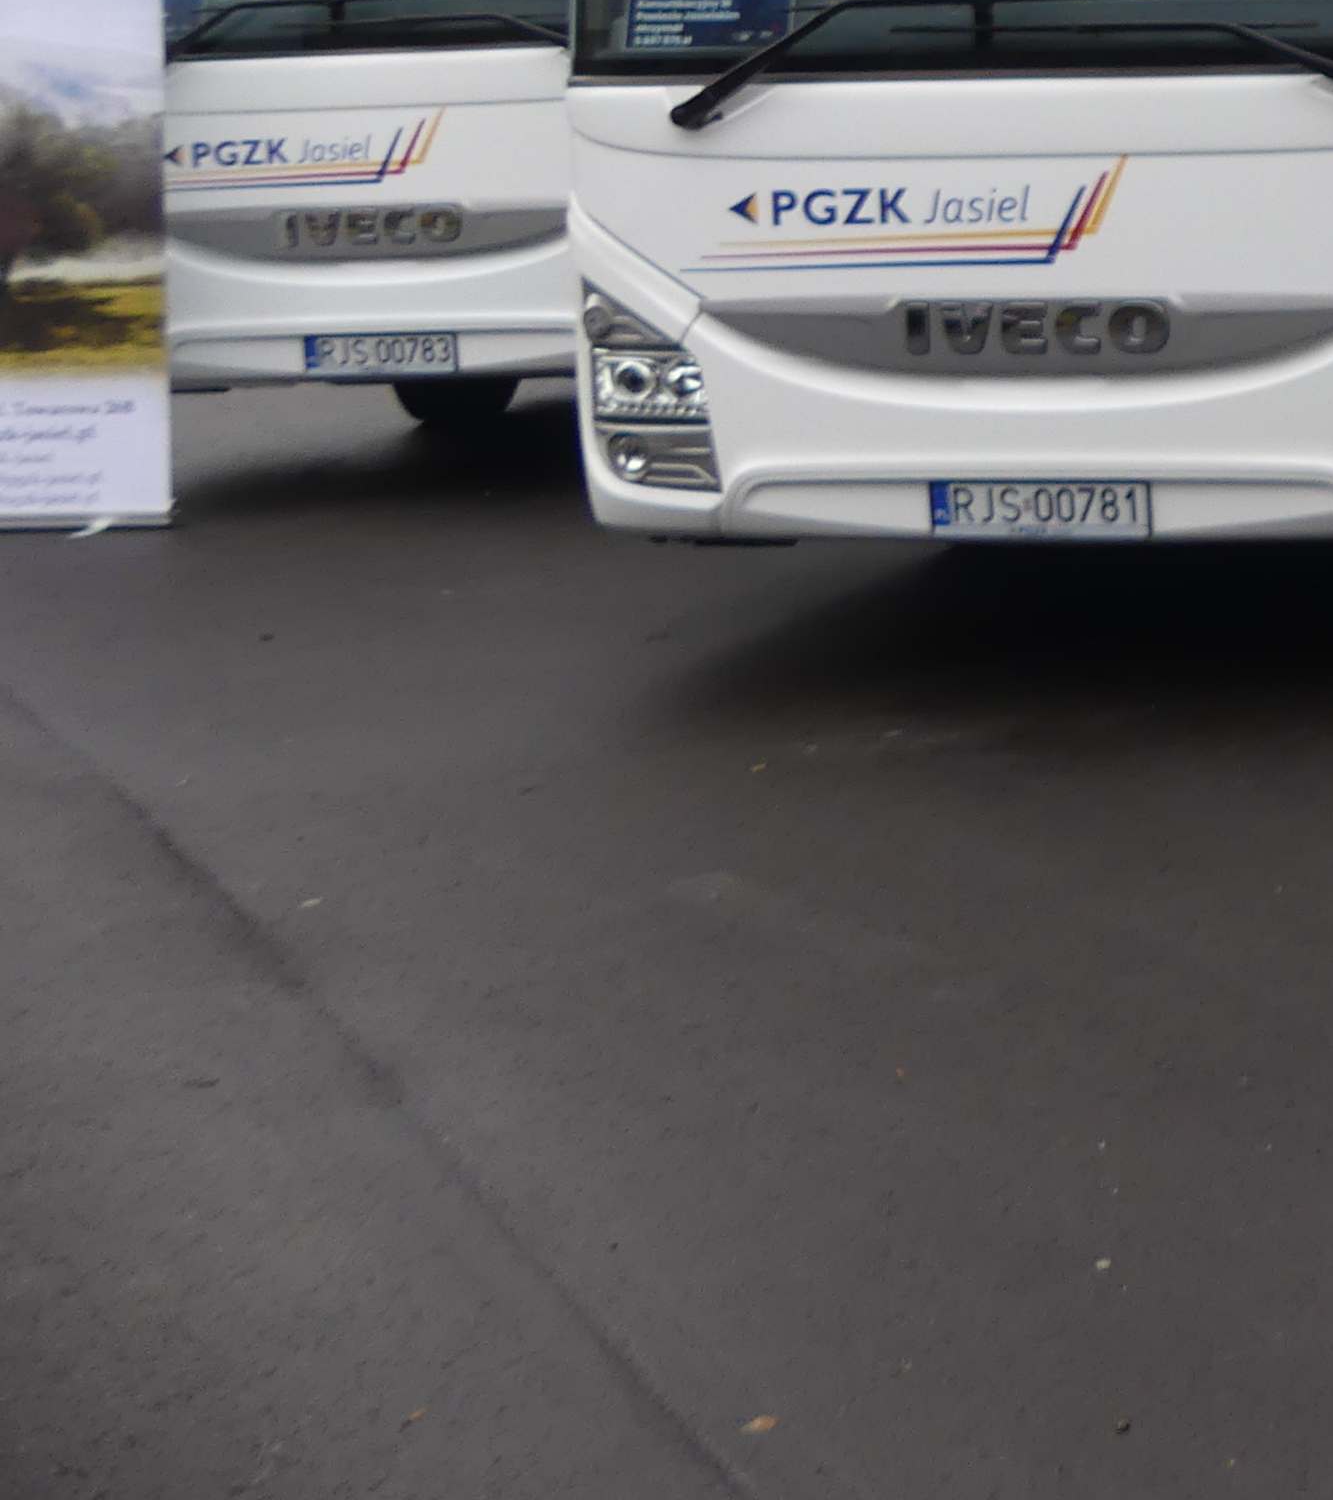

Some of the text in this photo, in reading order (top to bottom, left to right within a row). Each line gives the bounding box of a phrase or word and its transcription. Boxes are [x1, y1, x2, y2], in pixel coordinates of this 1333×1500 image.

[191, 134, 373, 168] PGZK Jasiel
[772, 184, 1030, 227] PGZK Jasiel
[284, 208, 464, 249] IVECO
[905, 300, 1171, 356] IVECO
[953, 487, 1137, 523] RJS 00781
